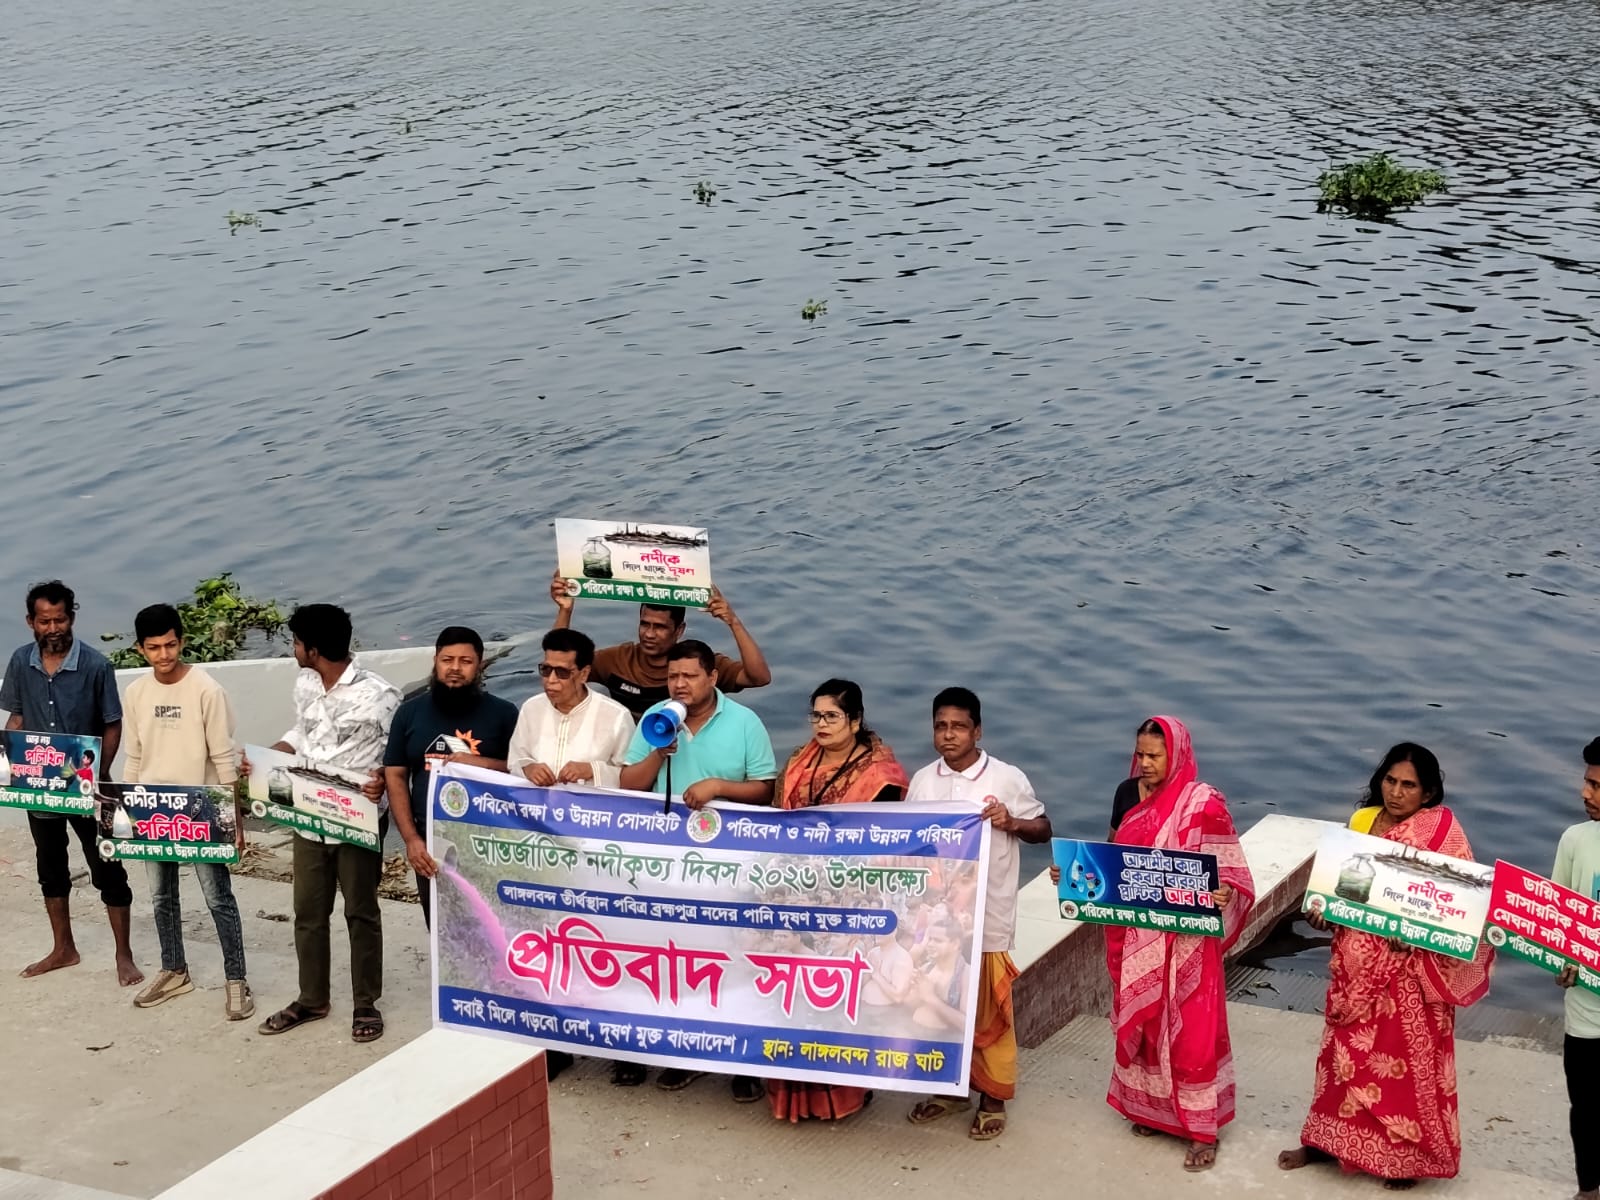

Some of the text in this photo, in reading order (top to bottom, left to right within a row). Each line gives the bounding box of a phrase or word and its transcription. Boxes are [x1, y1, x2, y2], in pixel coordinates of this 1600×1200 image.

[639, 549, 680, 566] নদীকে
[668, 566, 695, 577] দূষণ
[582, 580, 613, 595] পরিবেশ
[615, 585, 634, 597] রক্ষা
[637, 588, 644, 597] ও
[645, 584, 671, 600] উন্নয়ন
[25, 745, 65, 767] পলিথিন
[0, 788, 19, 803] রিবেশ
[122, 786, 189, 810] নদীর শত্রু
[136, 813, 211, 842] পলিথিন
[519, 803, 547, 822] রক্ষা
[552, 807, 565, 822] ও
[569, 803, 613, 829] উন্নয়ন
[617, 810, 682, 834] সোসাইটি
[726, 818, 781, 841] পরিবেশ
[786, 827, 798, 840] ও
[803, 823, 829, 842] নদী
[834, 827, 865, 844] রক্ষা
[868, 824, 911, 847] উন্নয়ন
[916, 824, 964, 845] পরিষদ
[116, 841, 145, 855] পরিবেশ
[147, 845, 163, 856] রক্ষা
[165, 846, 173, 856] ও
[174, 843, 199, 859] উন্নয়ন
[470, 833, 932, 896] আন্তর্জাতিক নদীকৃত্য দিবস ২০২৬ উপলক্ষ্যে
[1122, 850, 1202, 876] আগামীর কান্না
[1120, 869, 1165, 887] একবার
[1407, 881, 1455, 903] নদীকে
[503, 884, 888, 930] লাঙ্গলবন্দ তীর্থস্থান পবিত্র ব্রহ্মপুত্র নদের পানি দূষণ মুক্ত রাখতে
[1164, 887, 1195, 906] আর
[1196, 890, 1214, 909] না
[1504, 889, 1573, 930] রাসায়নিক
[1522, 876, 1561, 907] ডায়িং
[1565, 898, 1589, 917] এর
[1080, 904, 1220, 933] পরিবেশ রক্ষা ও উন্নয়ন সোসাইটি
[1436, 904, 1467, 920] দূষণ
[1328, 900, 1363, 923] পরিবেশ
[1365, 911, 1387, 929] রক্ষা
[1389, 919, 1398, 932] ও
[1400, 918, 1430, 941] উন্নয়ন
[1429, 930, 1475, 954] সোসাইটি
[1493, 908, 1600, 966] মেঘনা নদী রক্ষা
[1508, 935, 1544, 961] পরিবেশ
[1545, 951, 1566, 972] রক্ষা
[507, 916, 873, 1025] প্রতিবাদ সভা
[451, 997, 486, 1022] সবাই
[487, 1001, 516, 1026] মিলে
[519, 1010, 558, 1033] গড়বো
[562, 1018, 595, 1042] দেশ,
[598, 1022, 632, 1046] দূষণ
[636, 1026, 664, 1049] মুক্ত
[667, 1029, 737, 1055] বাংলাদেশ
[799, 1041, 870, 1066] লাঙ্গলবন্দ
[875, 1049, 908, 1071] রাজ
[914, 1050, 945, 1073] ঘাট
